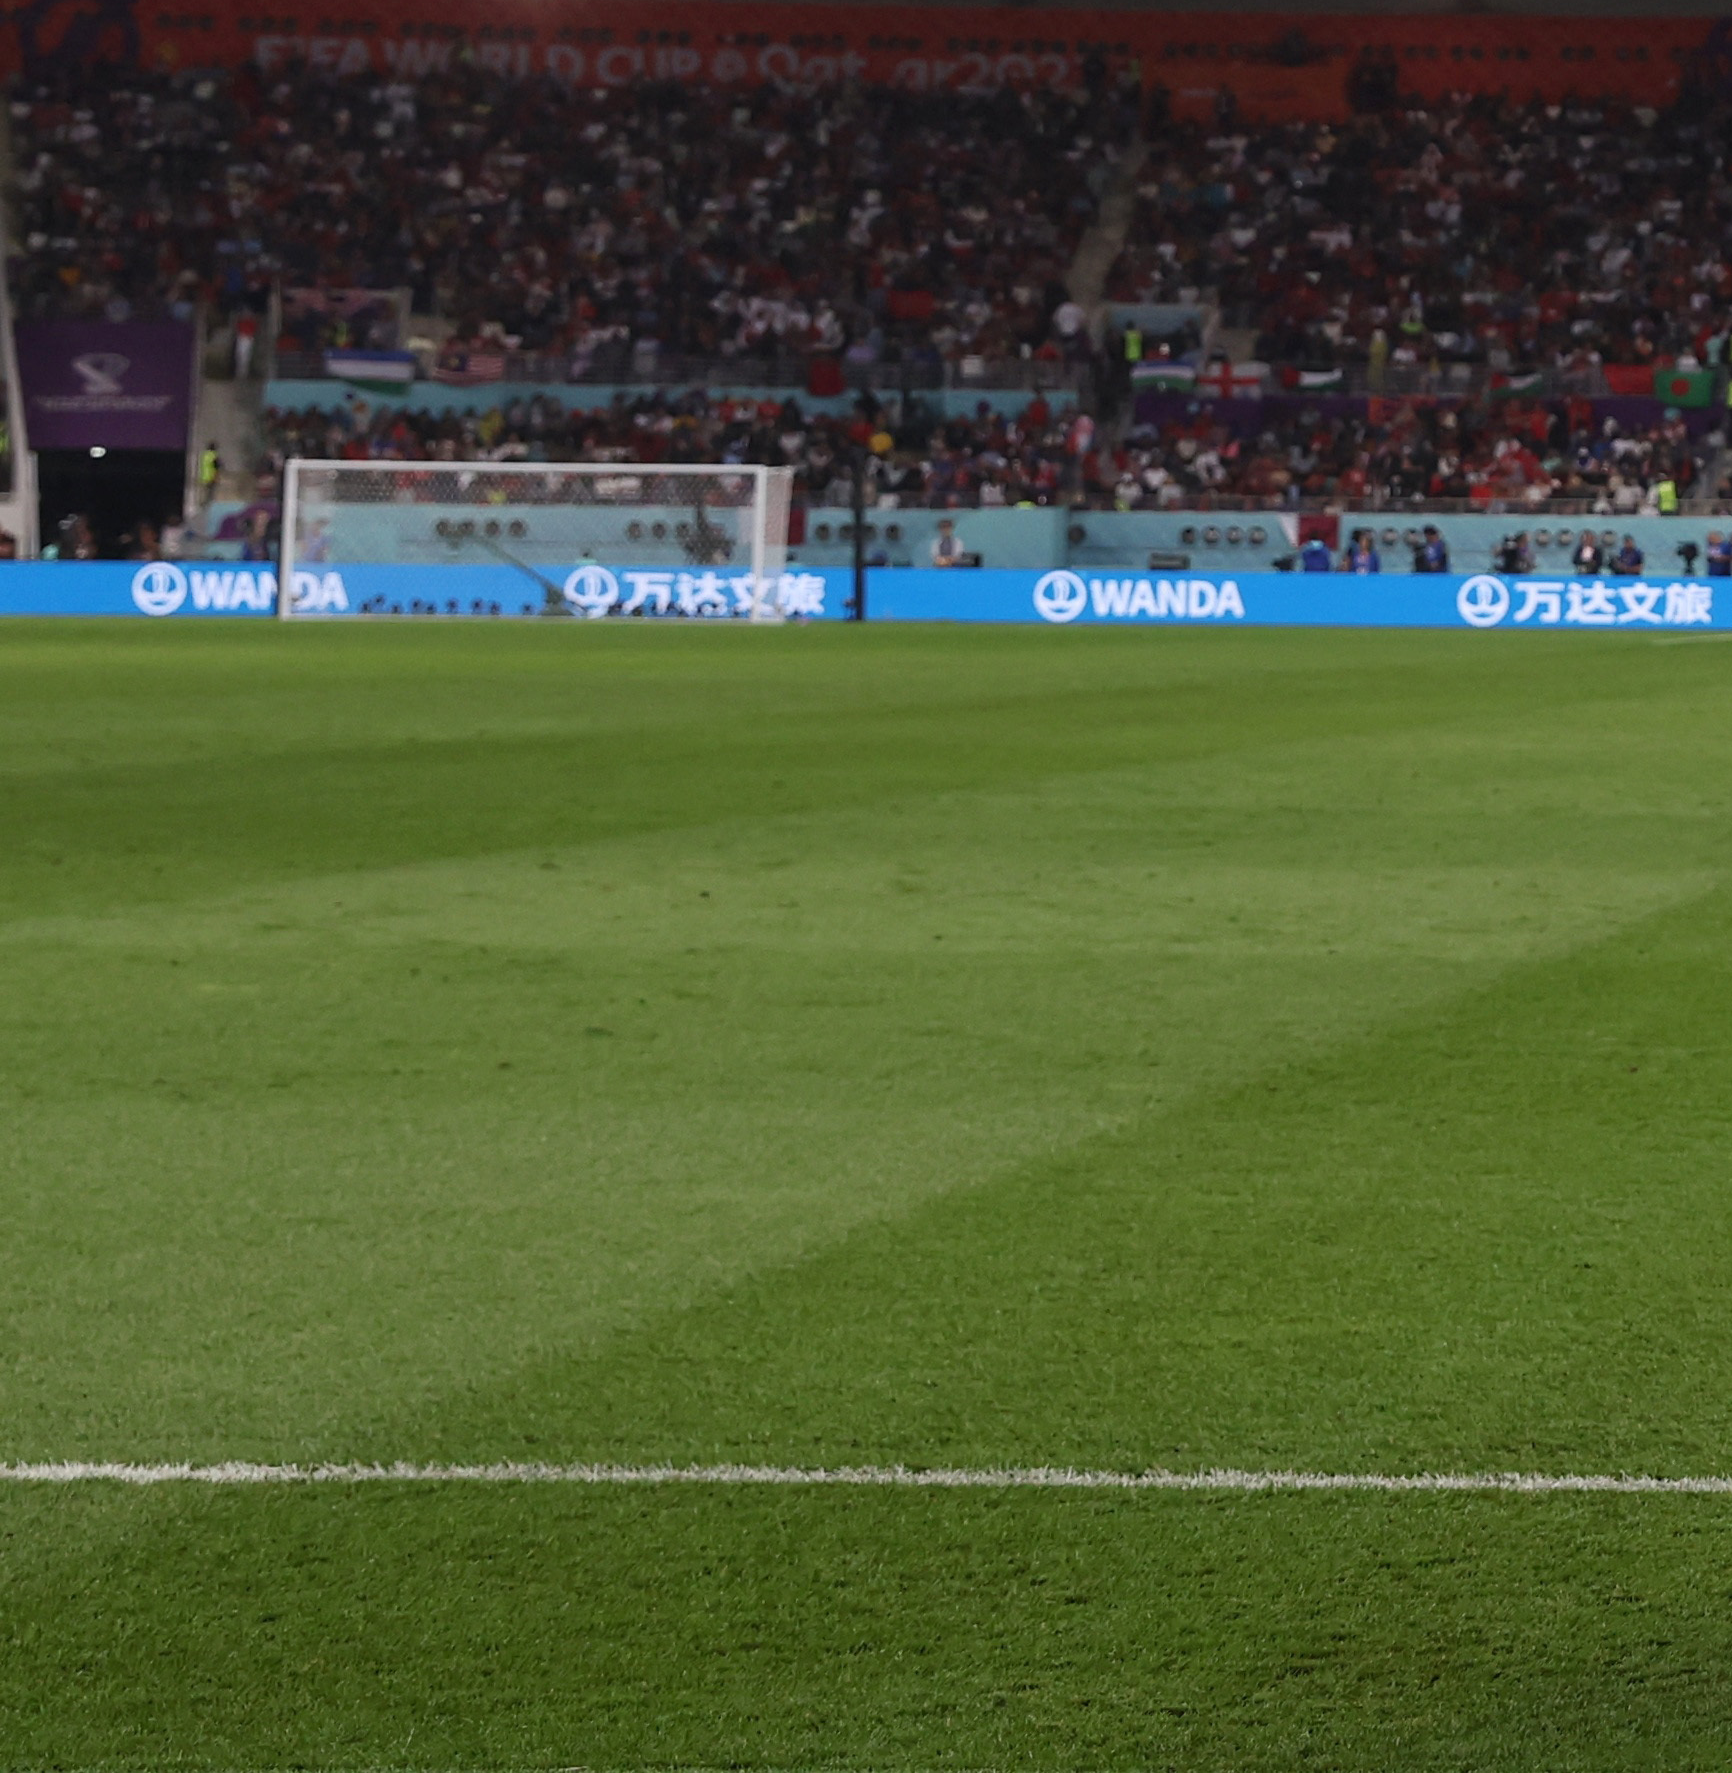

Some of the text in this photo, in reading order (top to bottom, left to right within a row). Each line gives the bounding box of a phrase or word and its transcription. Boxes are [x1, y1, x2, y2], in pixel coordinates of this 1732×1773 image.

[384, 38, 585, 87] WRLD
[190, 570, 349, 611] WANDA
[1091, 579, 1245, 619] WANDA
[1514, 581, 1713, 625] 万达文旅
